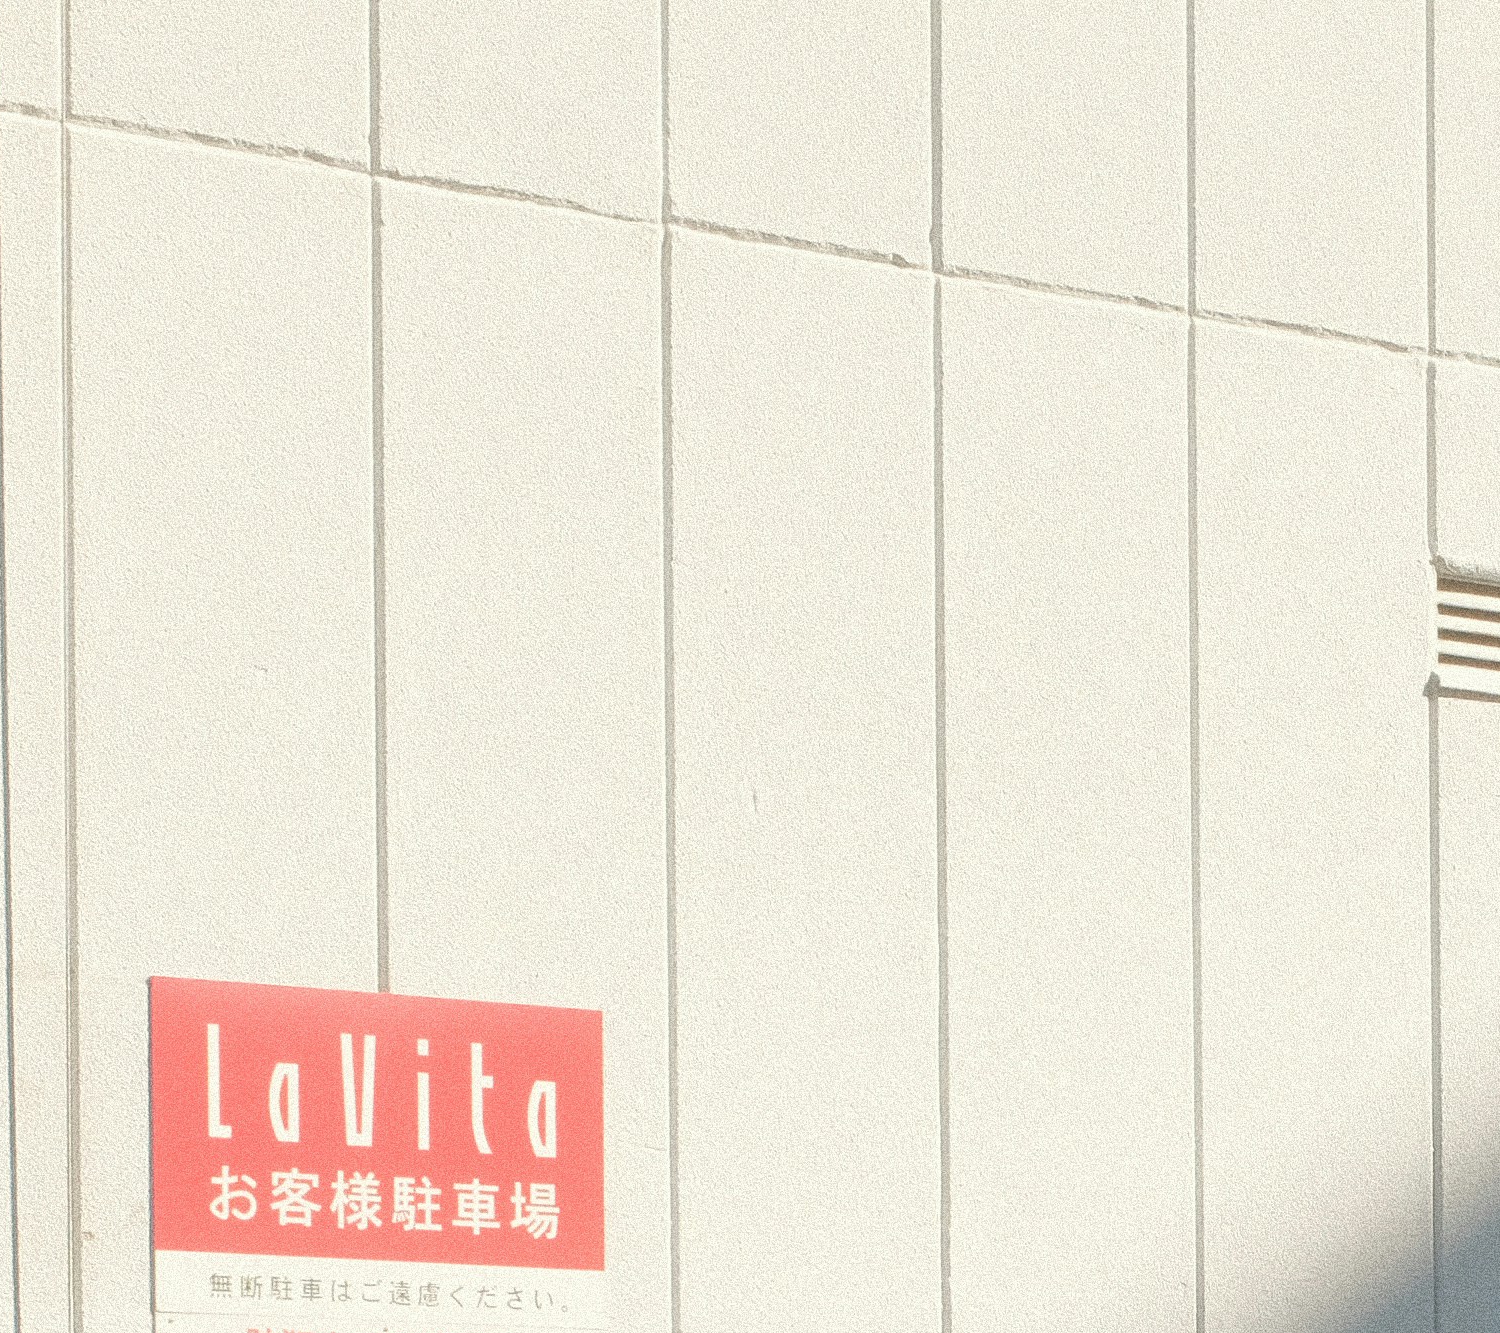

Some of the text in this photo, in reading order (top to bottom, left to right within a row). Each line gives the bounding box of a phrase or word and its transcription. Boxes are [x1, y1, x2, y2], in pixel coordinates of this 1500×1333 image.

[209, 1164, 561, 1240] お客様駐車場
[208, 1272, 569, 1314] 無断駐車はご遠慮ください。
